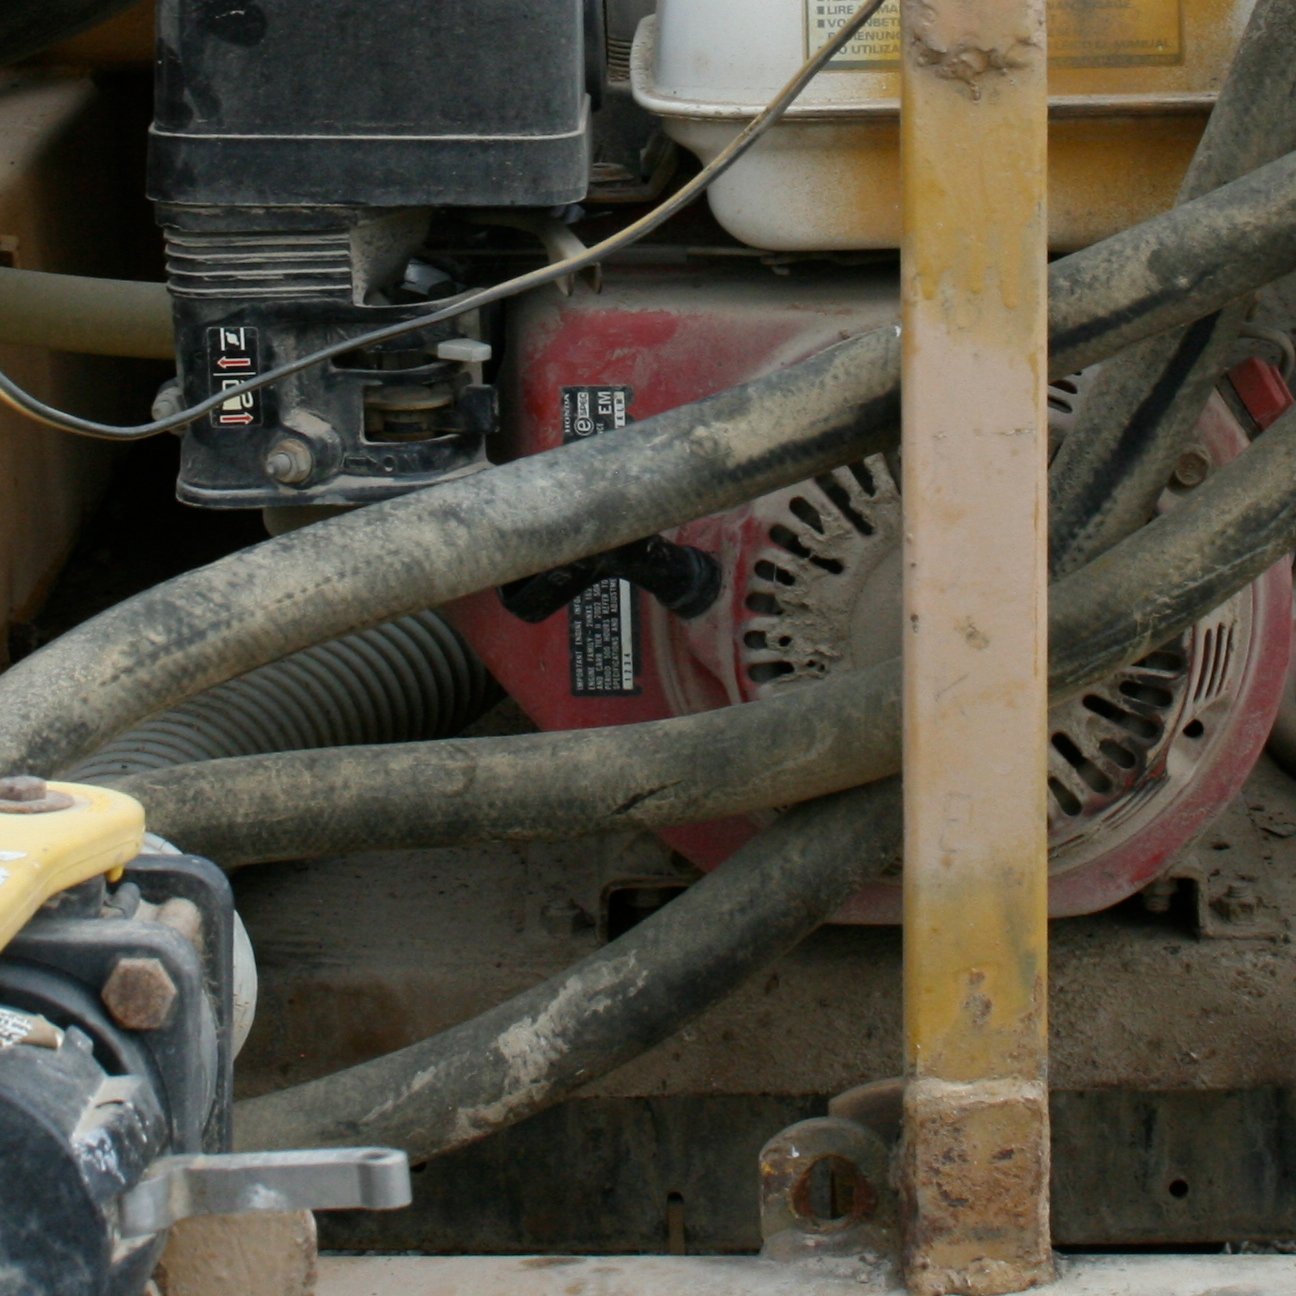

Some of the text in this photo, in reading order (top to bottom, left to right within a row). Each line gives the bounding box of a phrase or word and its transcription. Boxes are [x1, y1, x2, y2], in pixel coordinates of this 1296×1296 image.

[827, 5, 854, 15] LIRE
[851, 44, 899, 54] UTILIZA
[574, 621, 582, 646] ENGINE
[586, 637, 595, 662] FAMILY
[574, 651, 584, 691] IMPORTANT
[611, 636, 621, 691] SPECIFICATIONS
[587, 667, 596, 691] ENGINE
